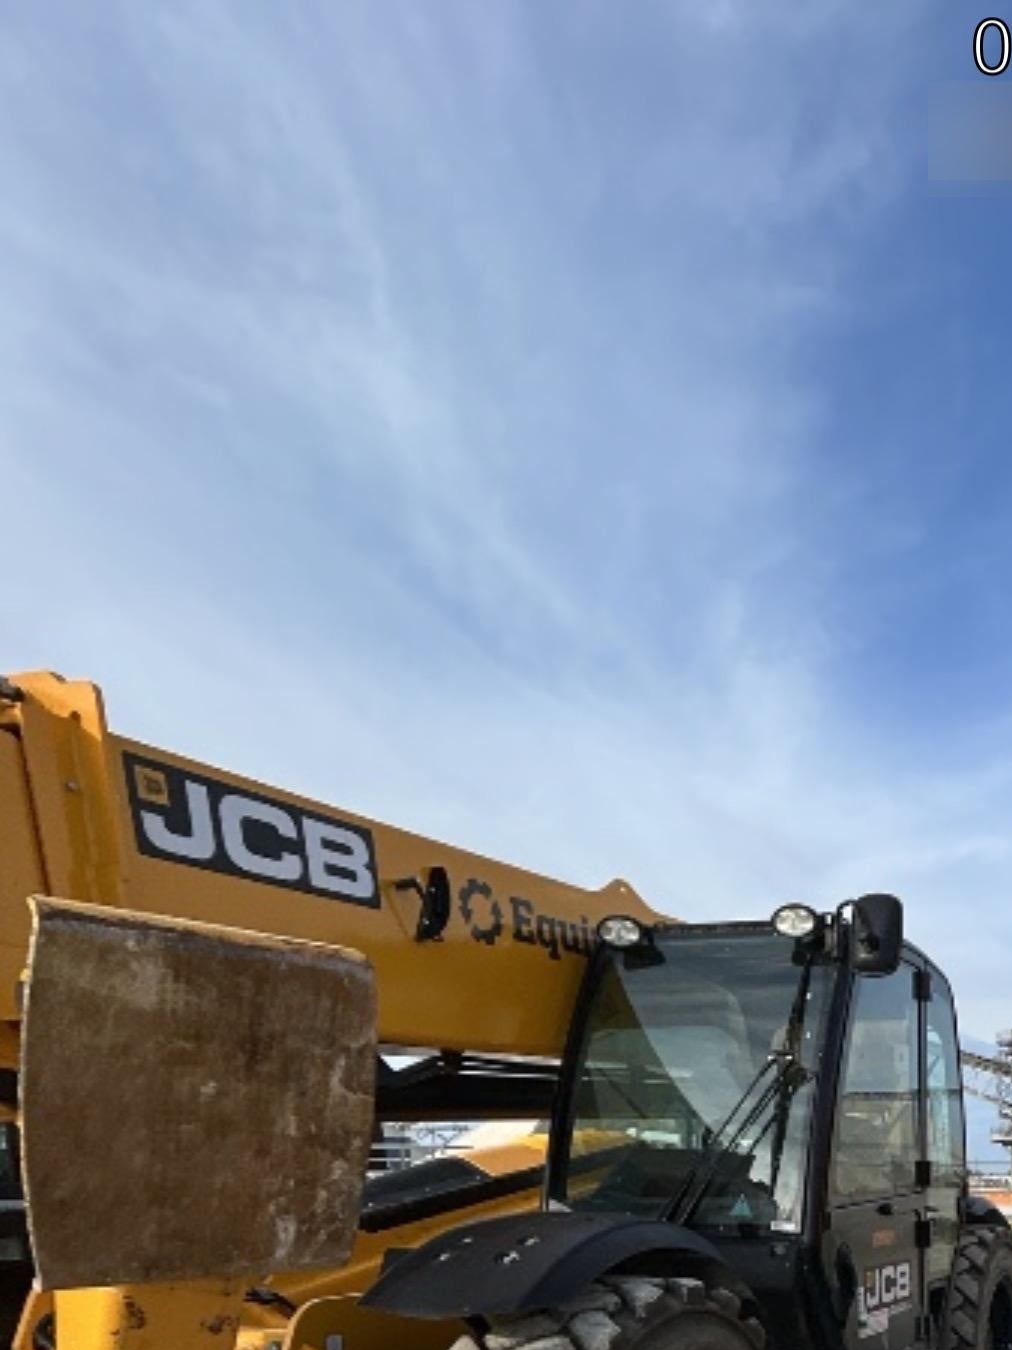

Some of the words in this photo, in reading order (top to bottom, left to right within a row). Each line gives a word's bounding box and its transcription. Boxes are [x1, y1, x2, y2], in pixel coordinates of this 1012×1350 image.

[140, 780, 375, 898] JCB
[510, 896, 598, 961] Equi
[866, 1262, 910, 1308] JCB
